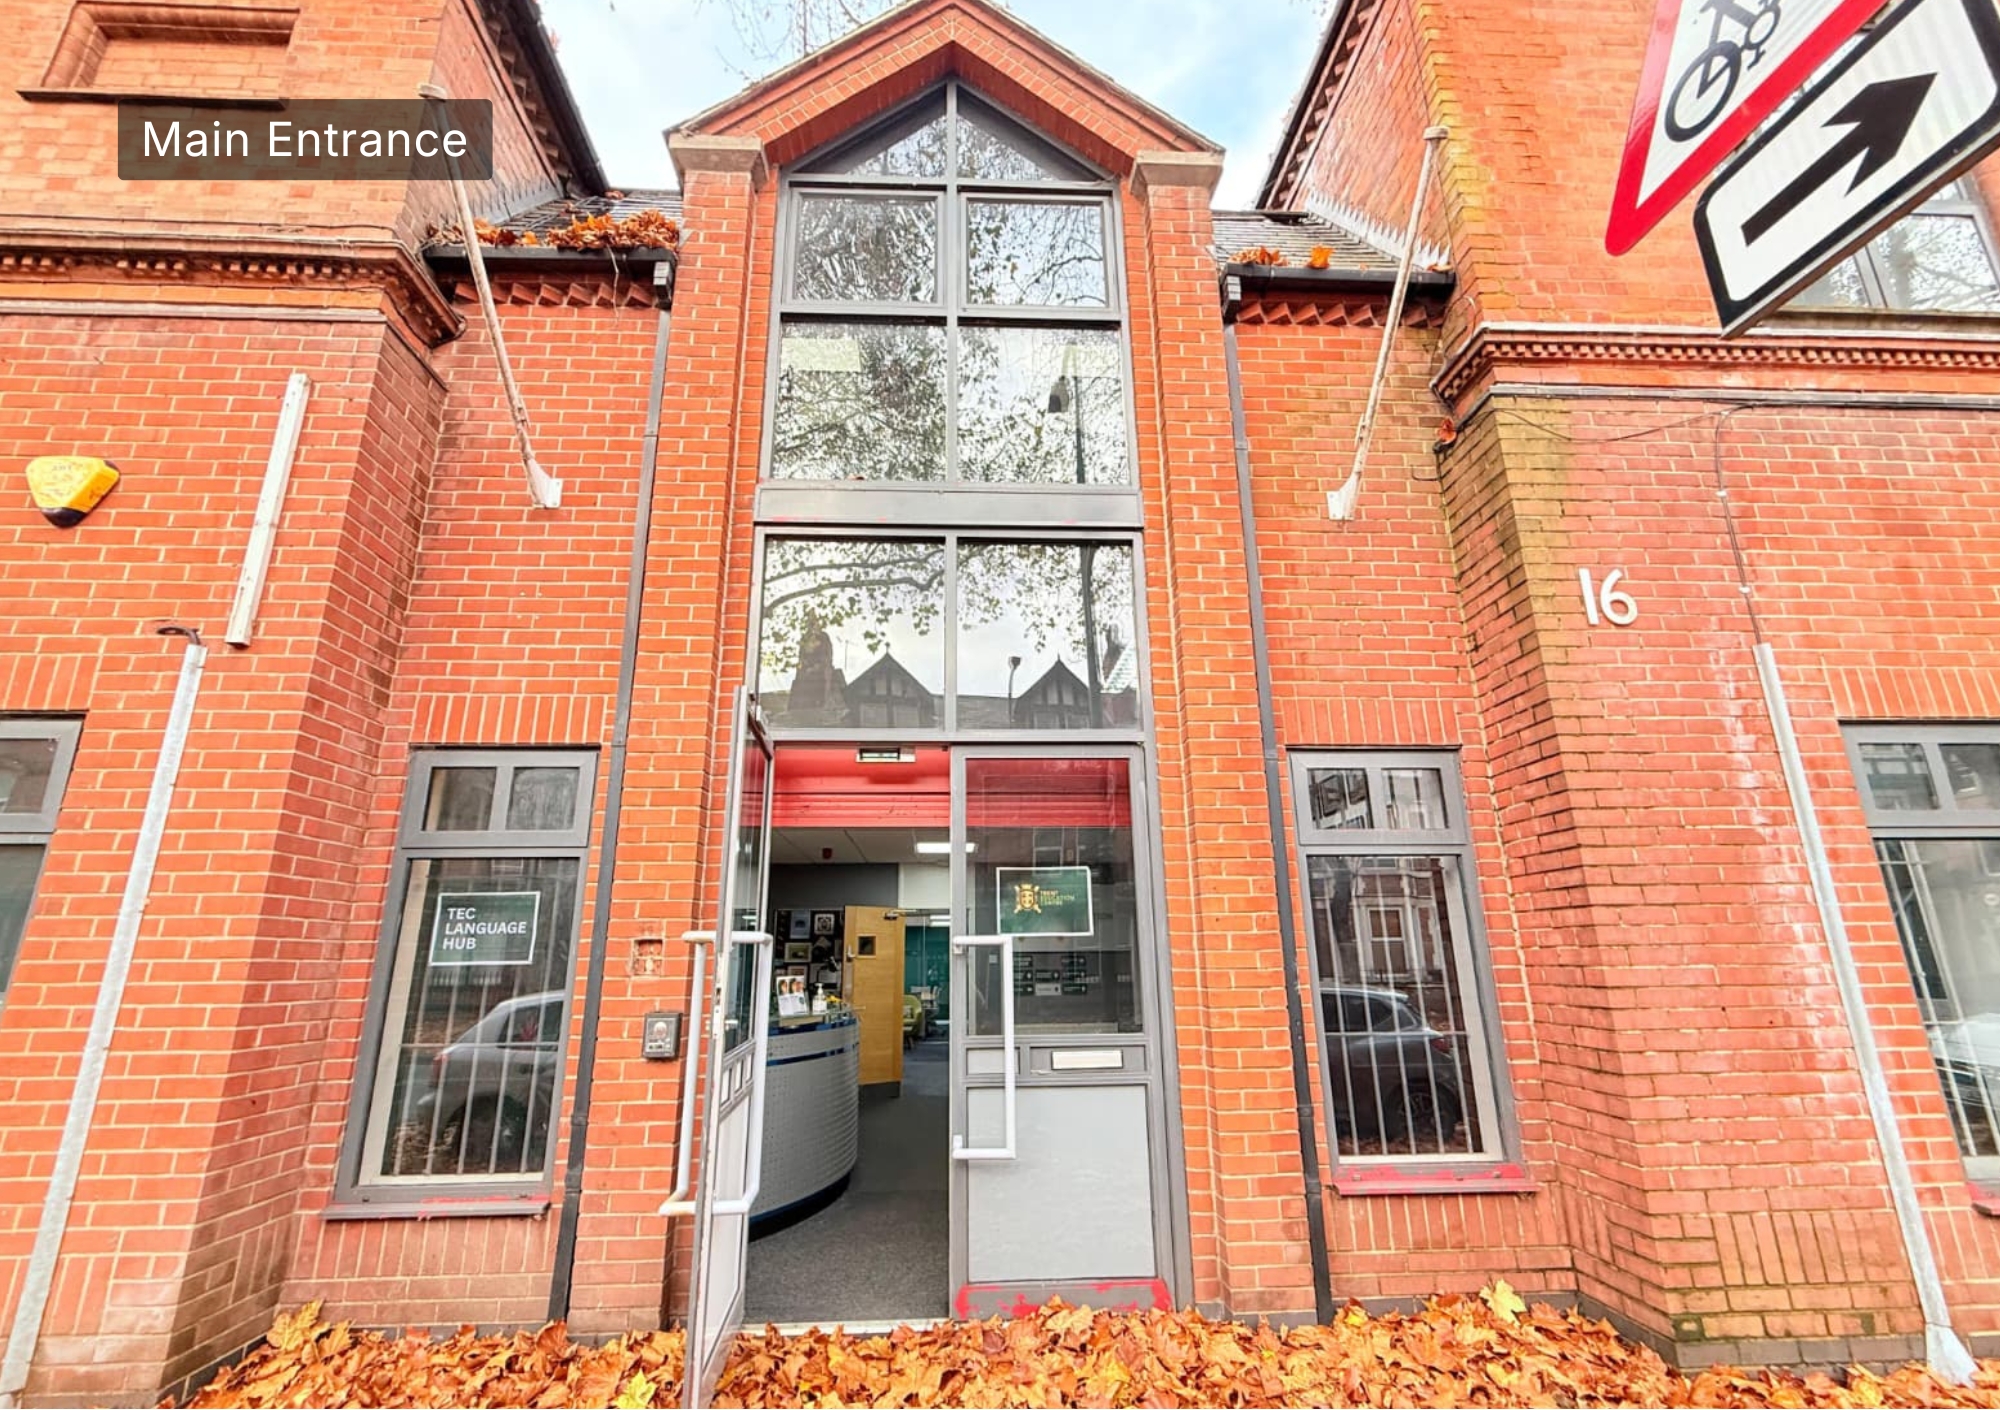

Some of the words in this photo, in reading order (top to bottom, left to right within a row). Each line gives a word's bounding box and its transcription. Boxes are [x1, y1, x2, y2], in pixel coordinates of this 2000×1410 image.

[1578, 567, 1638, 626] 16
[447, 907, 477, 920] TEC
[445, 921, 528, 935] LANGUAGE
[442, 937, 477, 950] HUB
